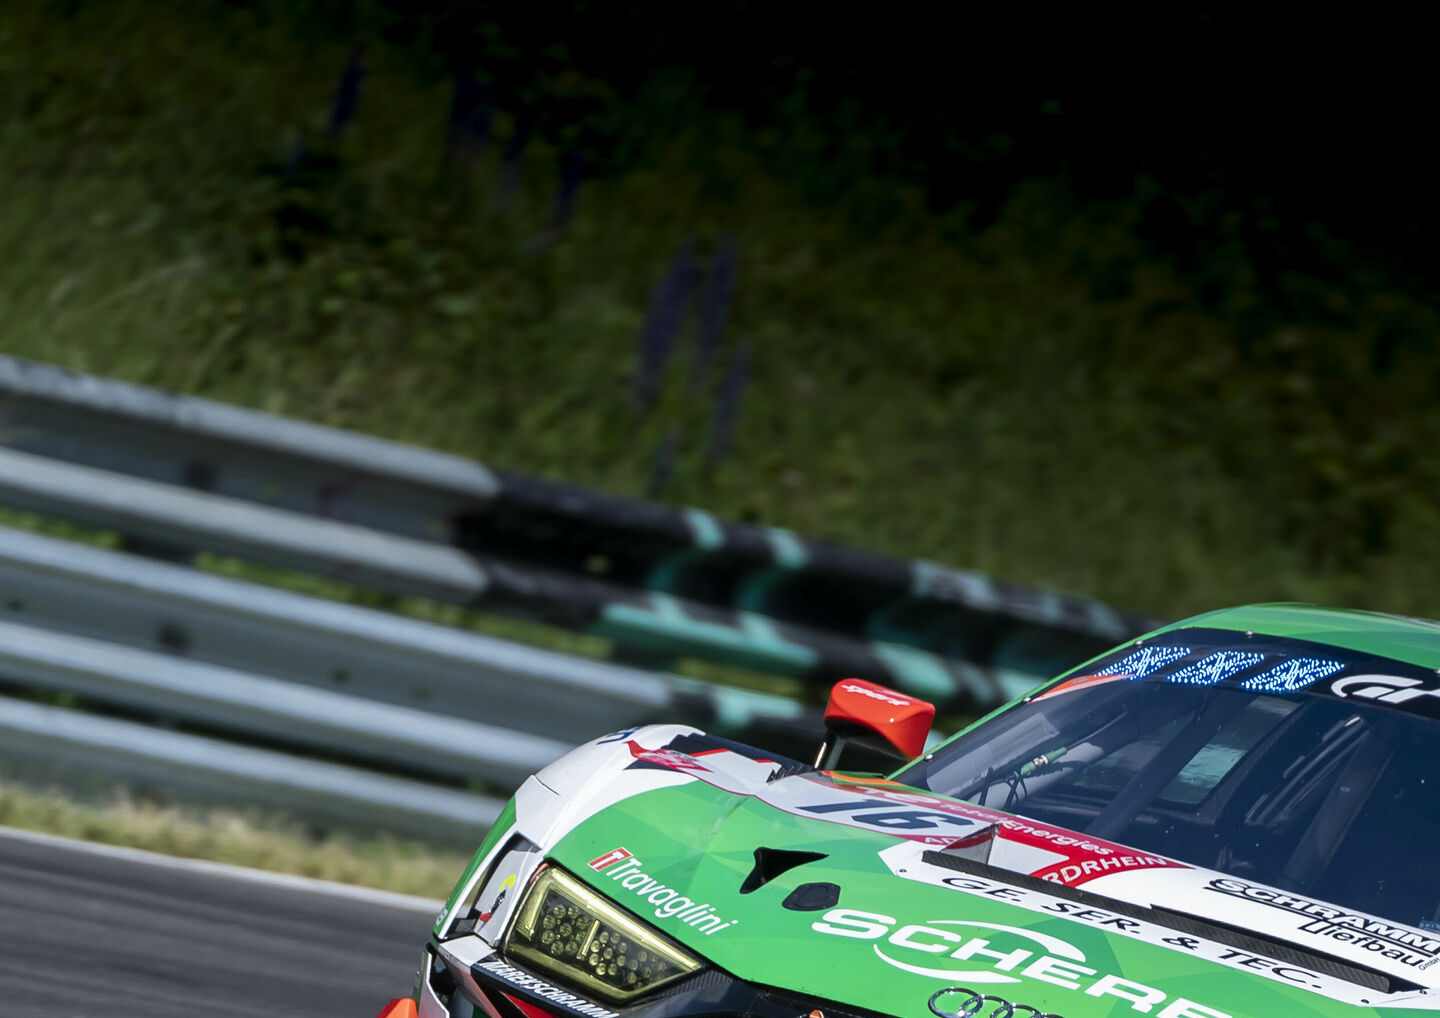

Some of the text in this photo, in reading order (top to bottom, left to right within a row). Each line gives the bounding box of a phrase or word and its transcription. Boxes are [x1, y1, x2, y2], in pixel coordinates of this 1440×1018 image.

[794, 798, 976, 831] 16
[604, 856, 740, 937] Travaglini
[1041, 900, 1141, 935] SER.
[1161, 935, 1200, 953] &
[1218, 948, 1323, 989] TEC.
[1298, 919, 1428, 971] Tiefbau
